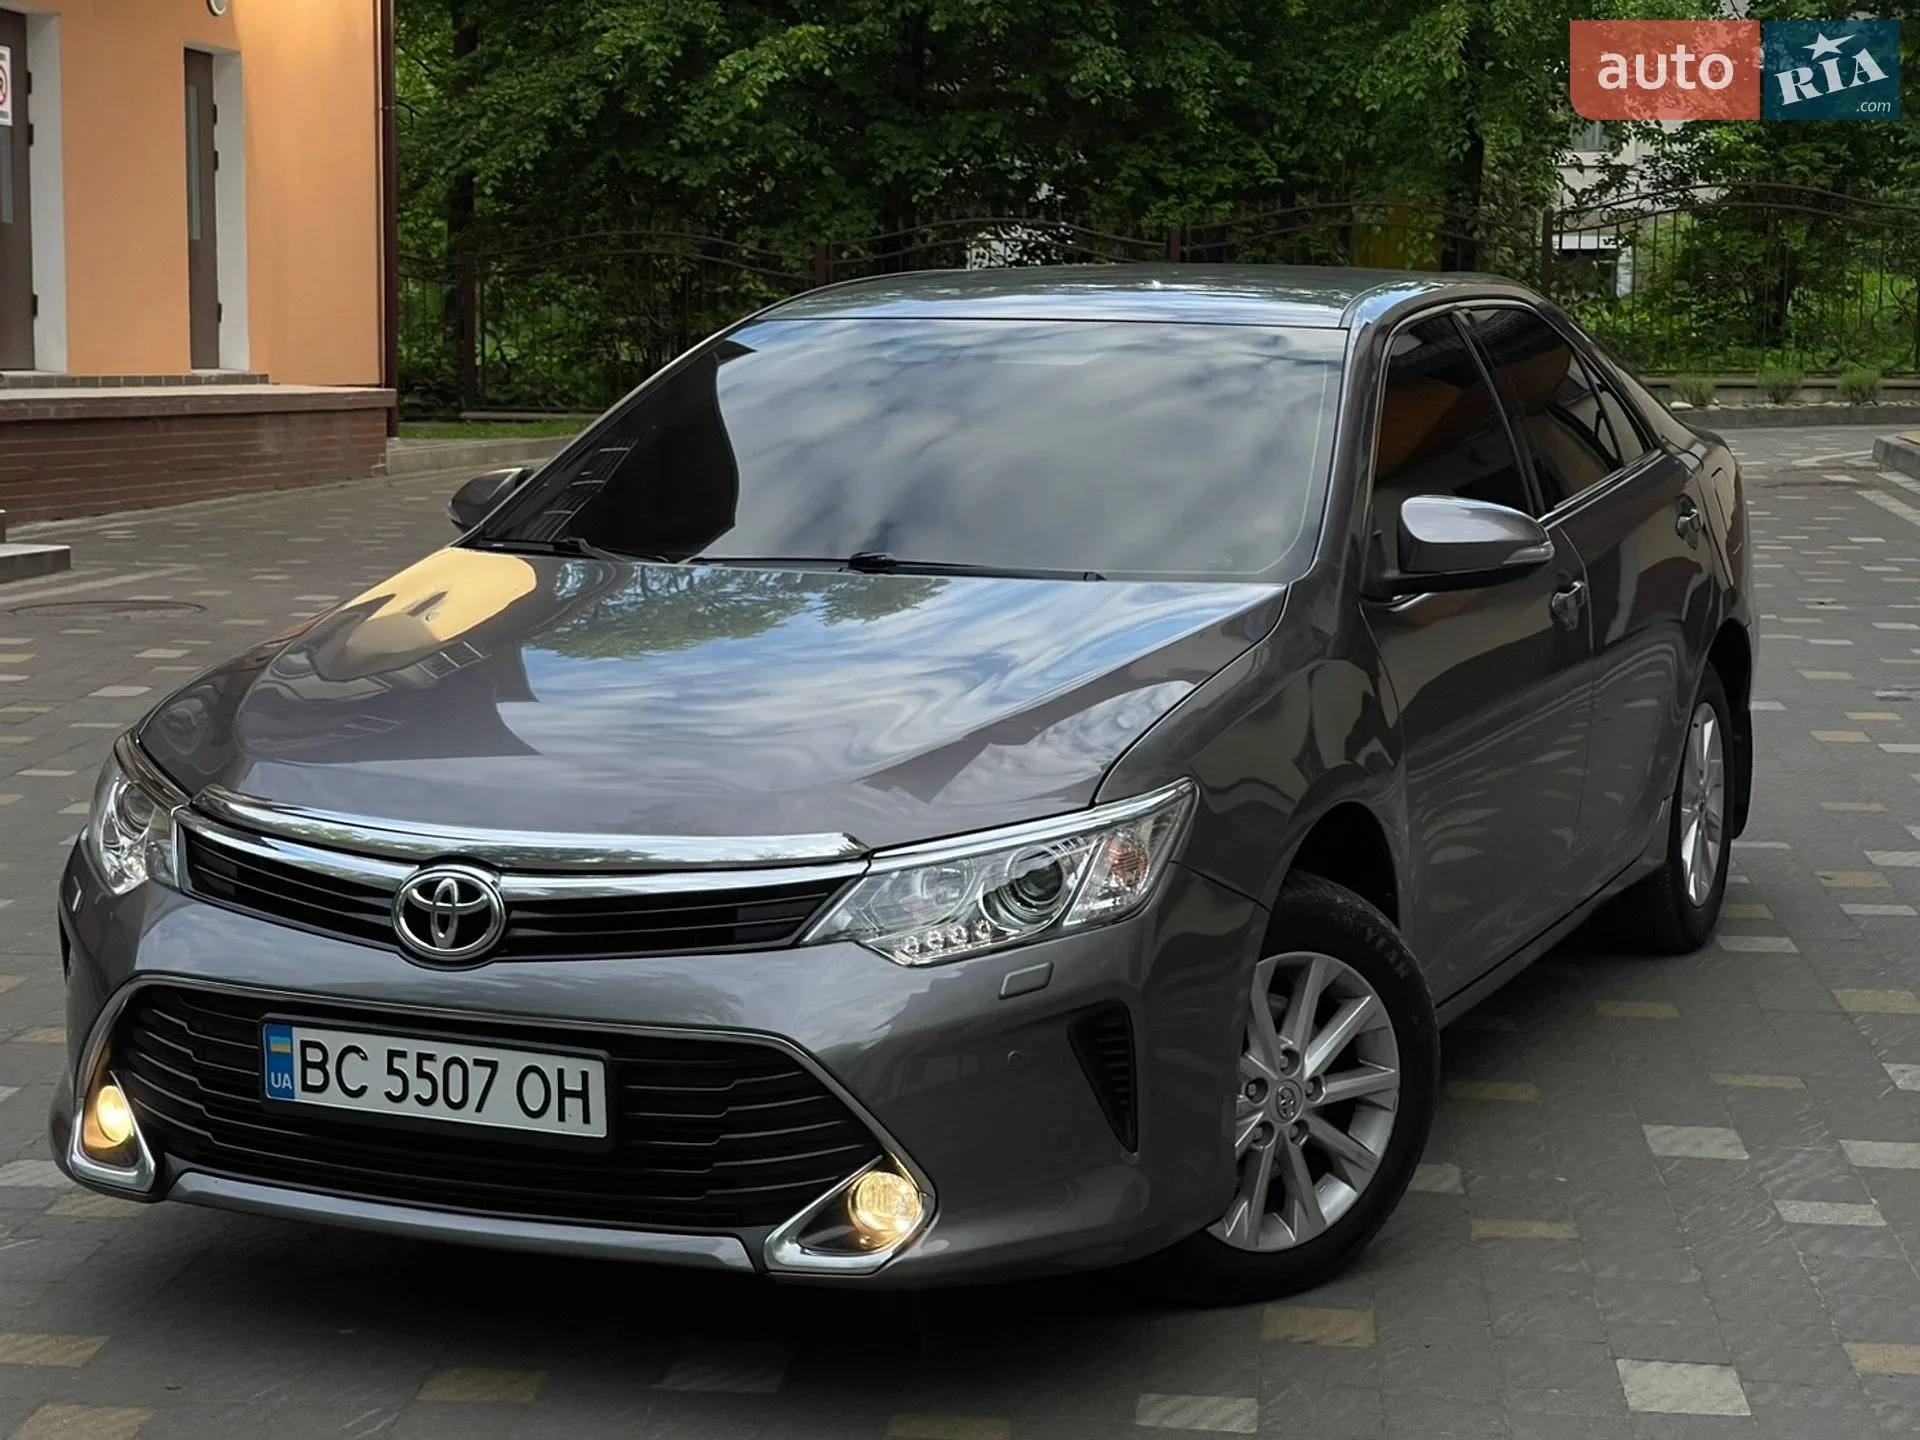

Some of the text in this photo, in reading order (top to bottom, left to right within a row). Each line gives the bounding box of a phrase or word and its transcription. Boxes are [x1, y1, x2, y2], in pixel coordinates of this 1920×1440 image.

[271, 1073, 293, 1091] UA
[300, 1039, 592, 1125] BC 5507 OH
